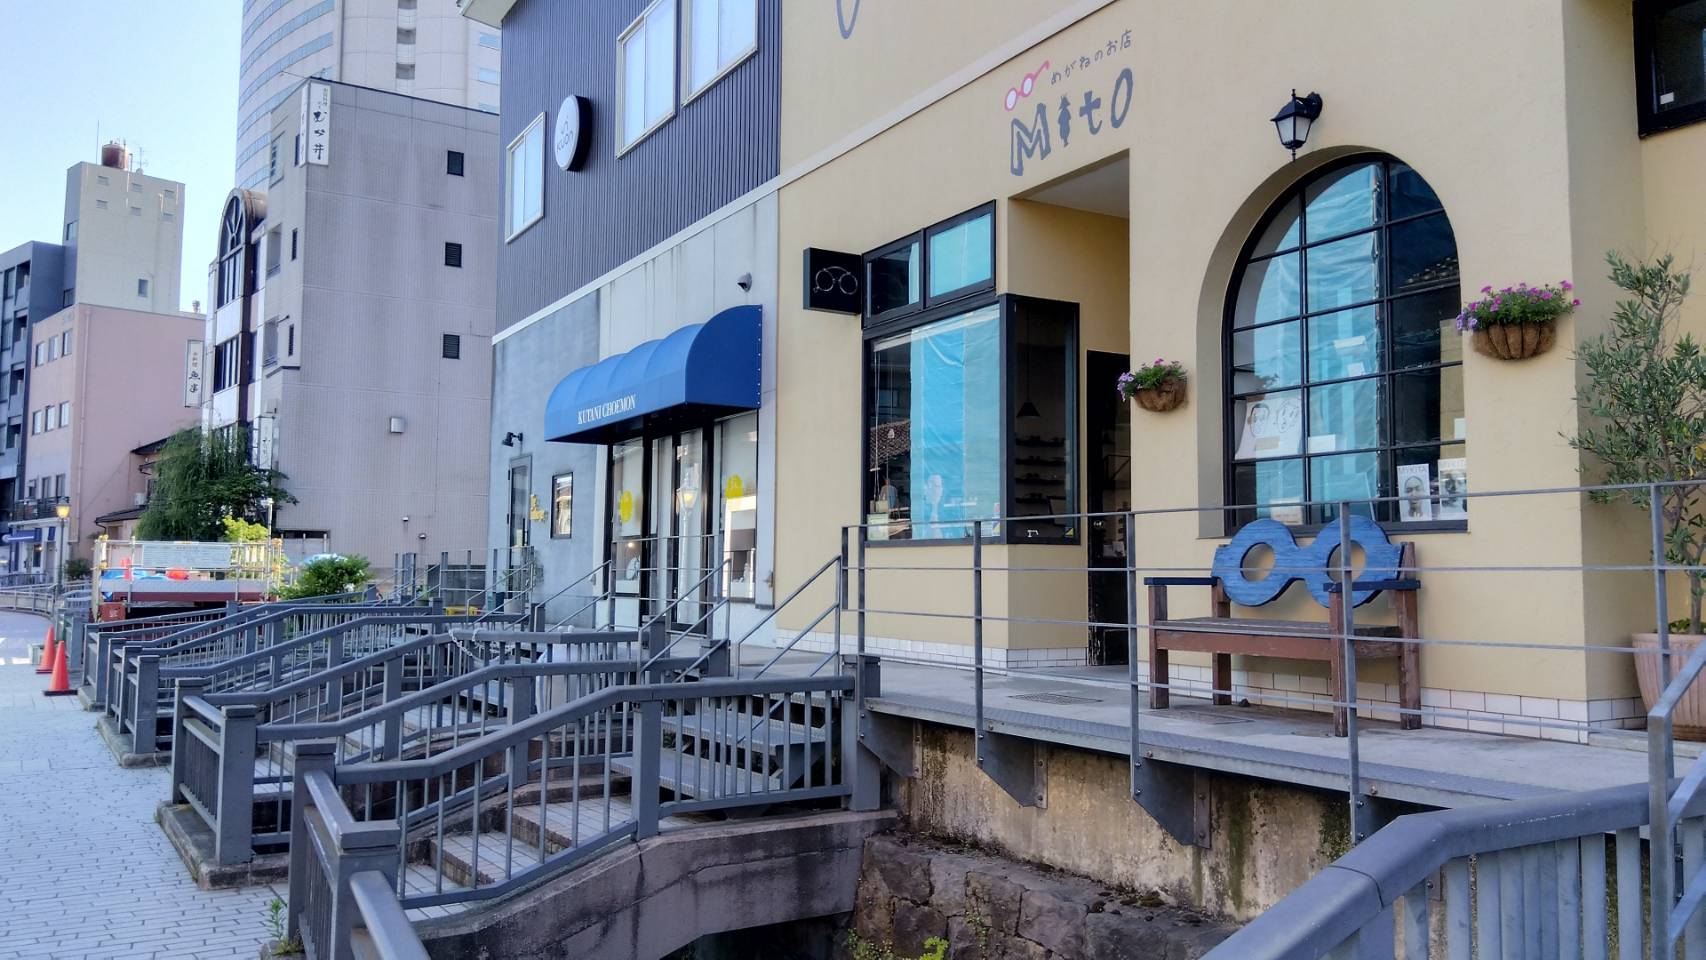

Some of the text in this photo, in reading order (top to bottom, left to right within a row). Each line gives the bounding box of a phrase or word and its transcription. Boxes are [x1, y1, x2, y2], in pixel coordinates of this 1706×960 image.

[1050, 29, 1132, 85] めがねのお店
[577, 405, 602, 425] KUTANI
